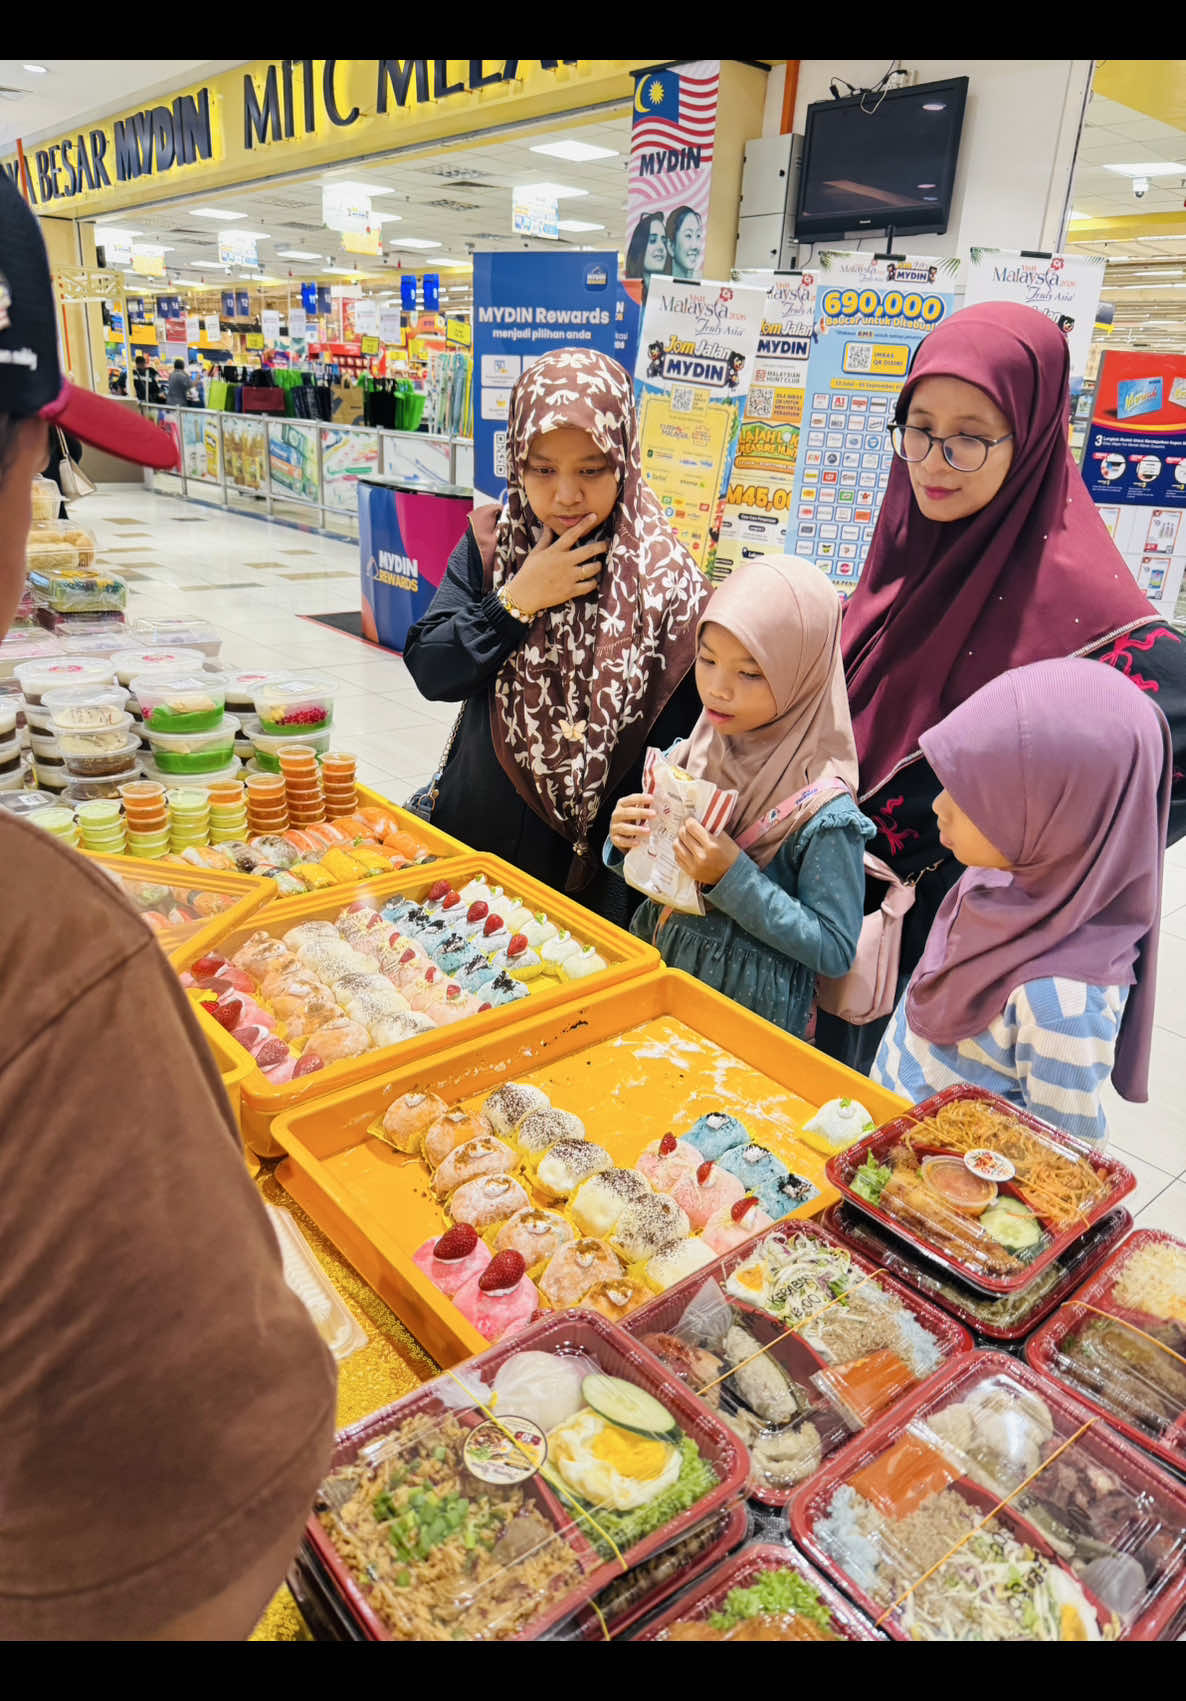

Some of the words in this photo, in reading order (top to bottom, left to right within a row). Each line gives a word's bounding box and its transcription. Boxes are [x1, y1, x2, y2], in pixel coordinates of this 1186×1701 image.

[36, 130, 111, 203] BESAR
[114, 88, 213, 181] MYDIN
[244, 60, 360, 150] MITC
[639, 145, 702, 177] MYDIN
[896, 271, 926, 281] MYDIN
[992, 267, 1060, 287] Malaysia
[478, 307, 533, 323] MYDIN
[535, 307, 610, 324] Rewards
[660, 296, 729, 320] Malaysia
[823, 290, 943, 324] 690,000
[493, 328, 531, 341] menjadi
[531, 328, 565, 341] pilihan
[566, 329, 592, 340] anda
[665, 336, 696, 355] Jom
[696, 338, 733, 360] Jalan
[757, 339, 808, 355] MYDIN
[667, 359, 724, 381] MYDIN
[1094, 434, 1103, 447] 3
[378, 550, 418, 578] MYDIN
[379, 569, 419, 593] REWARDS
